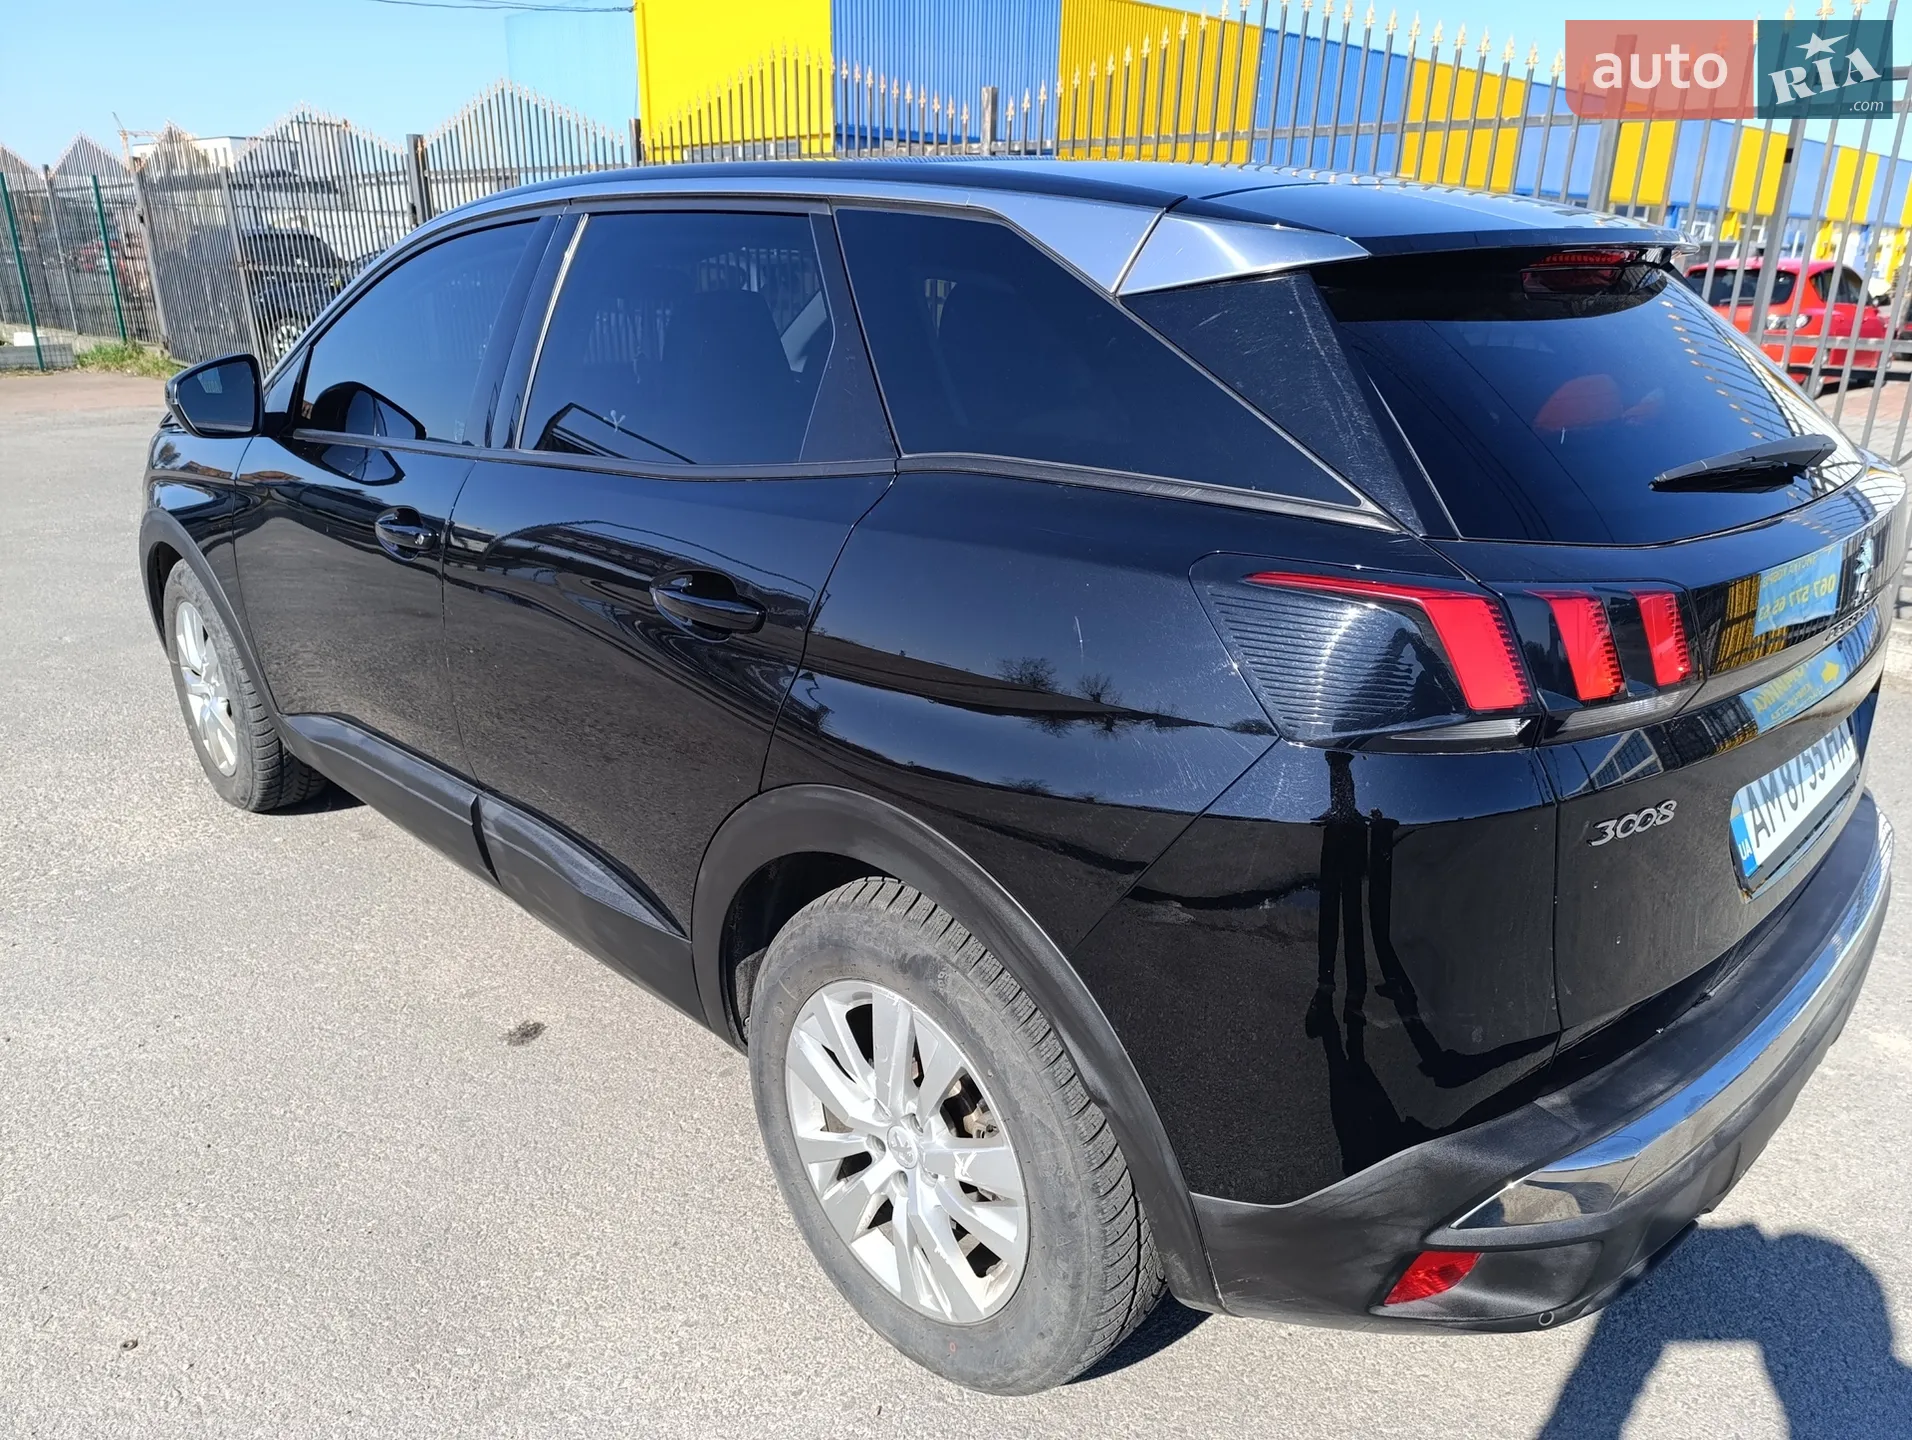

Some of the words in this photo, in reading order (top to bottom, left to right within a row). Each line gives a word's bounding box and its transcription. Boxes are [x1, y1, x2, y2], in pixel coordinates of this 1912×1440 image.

[1586, 798, 1678, 847] 3008
[1745, 774, 1787, 848] AM
[1738, 839, 1753, 861] UA
